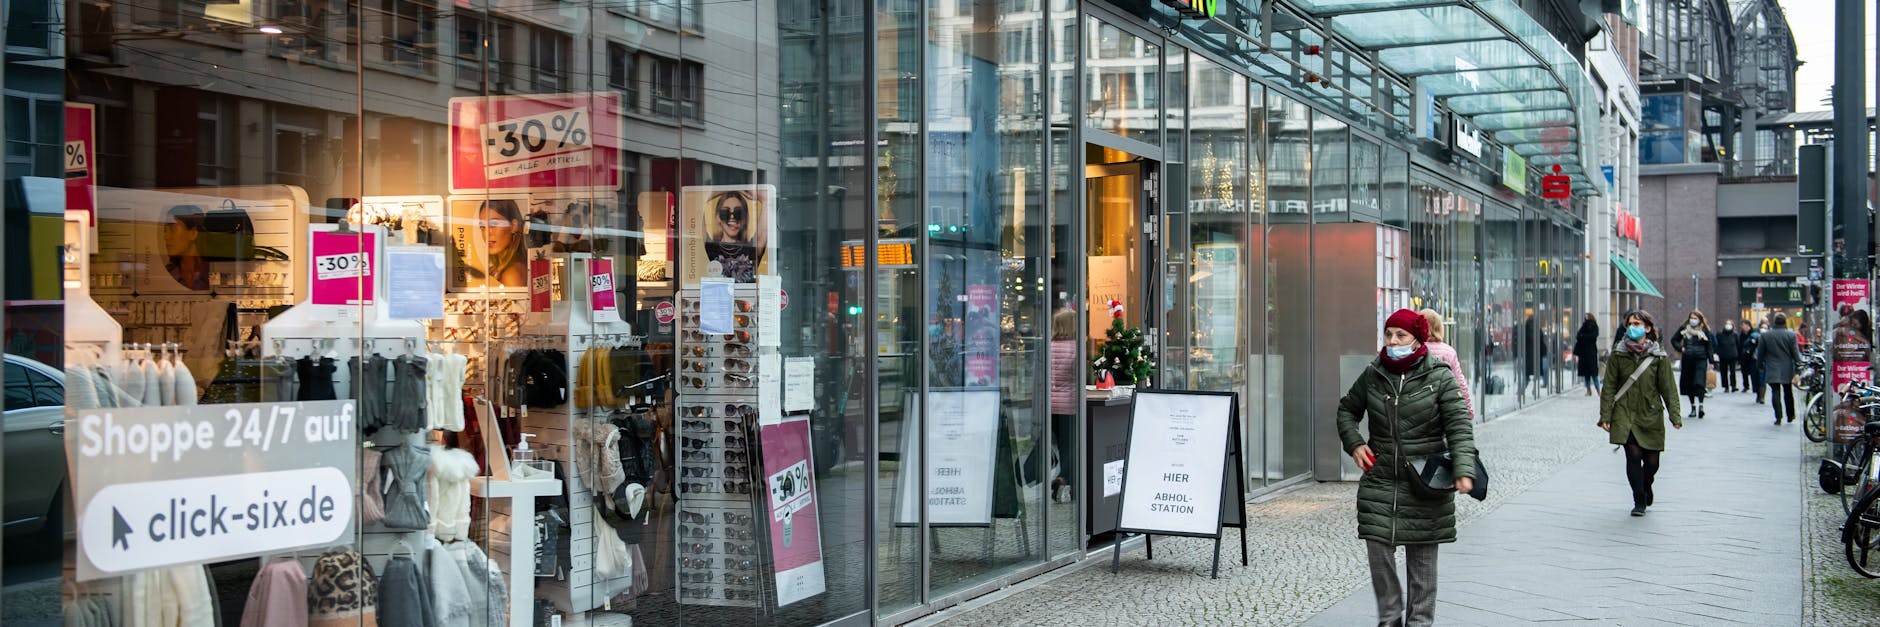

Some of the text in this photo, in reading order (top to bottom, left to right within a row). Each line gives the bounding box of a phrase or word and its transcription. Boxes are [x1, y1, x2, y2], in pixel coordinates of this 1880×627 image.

[517, 160, 540, 171] ALLE
[546, 155, 582, 166] ARTIKEL
[81, 403, 353, 462] Shoppe 24/7 auf
[1163, 472, 1189, 483] HIER
[1154, 492, 1193, 503] ABHOL-
[149, 484, 335, 542] click-six.de
[1151, 503, 1194, 514] STATION
